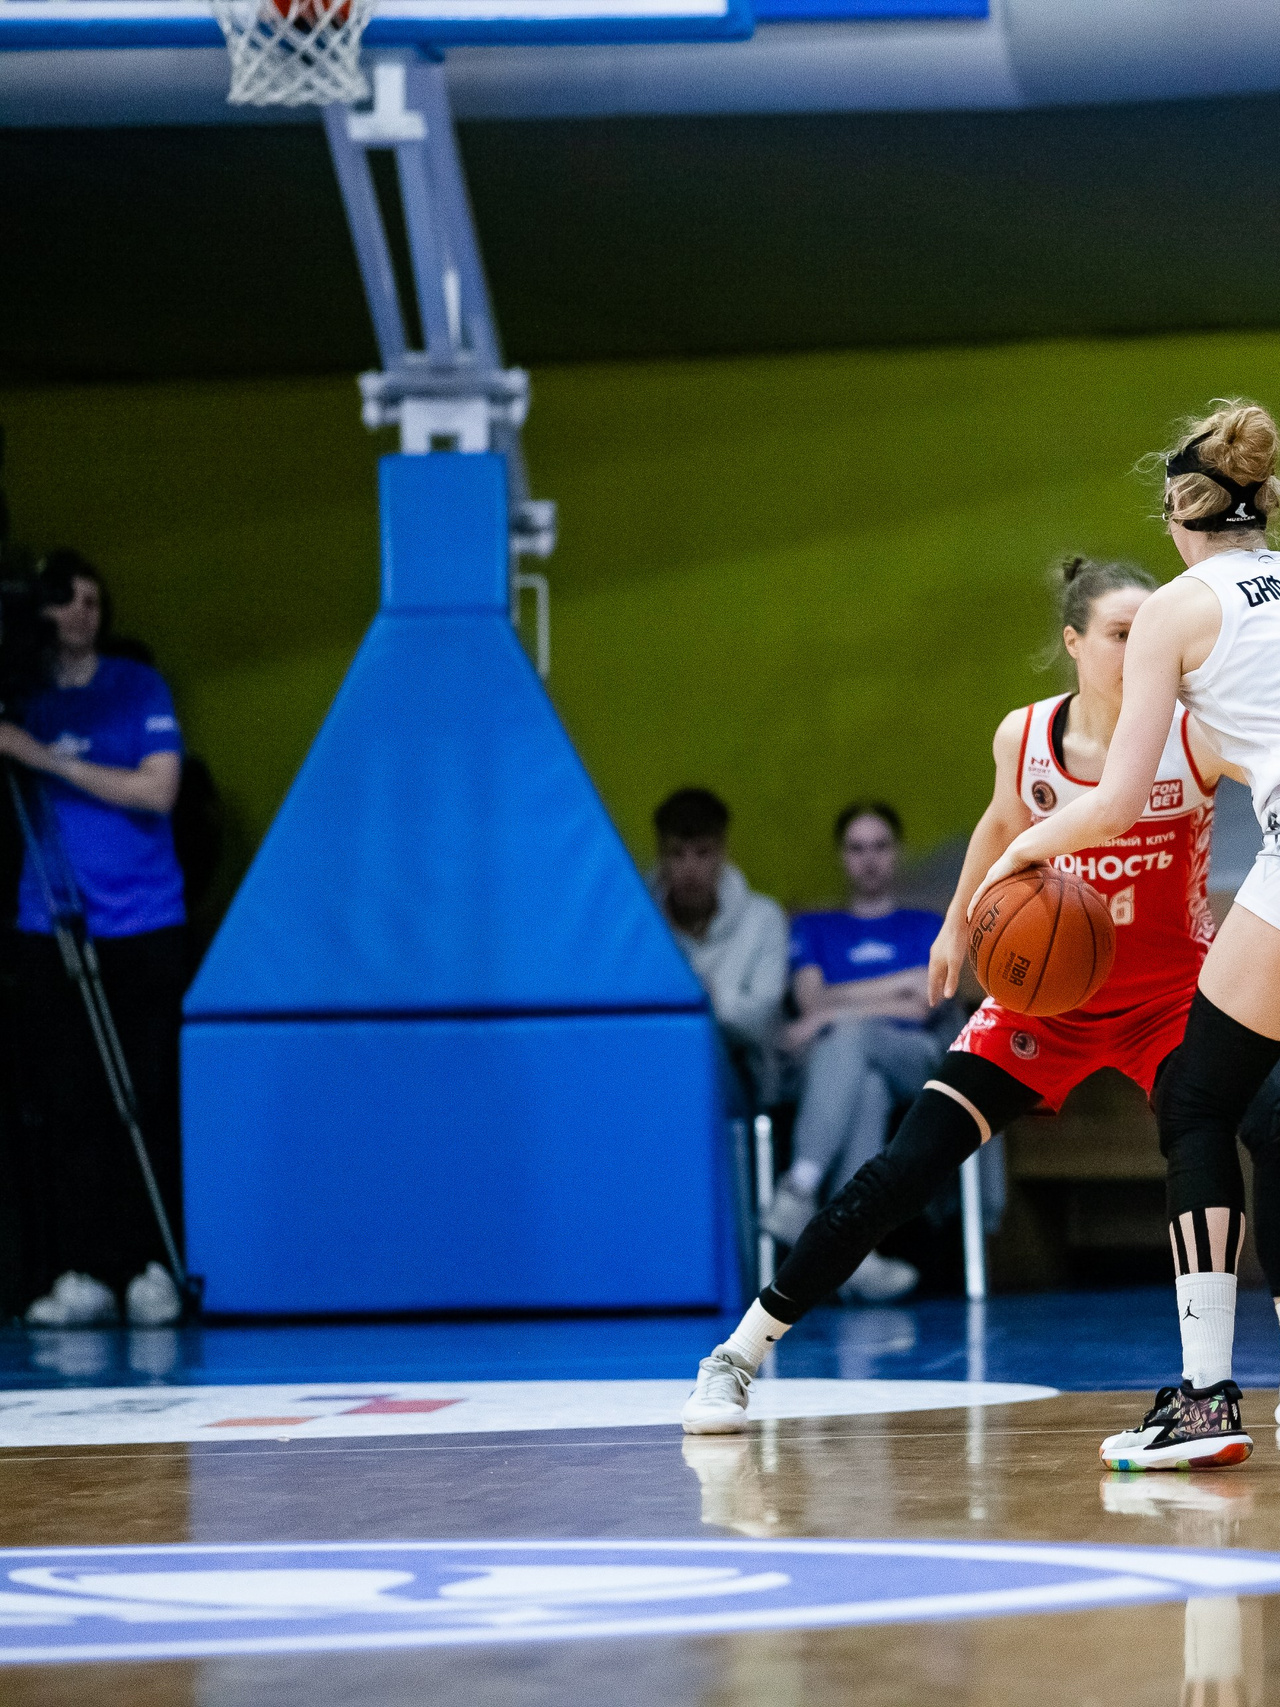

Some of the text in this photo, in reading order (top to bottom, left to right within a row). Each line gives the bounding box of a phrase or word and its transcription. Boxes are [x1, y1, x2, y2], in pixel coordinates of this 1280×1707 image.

[1152, 781, 1180, 796] FON
[1152, 793, 1181, 808] BET
[1098, 830, 1176, 847] ЬНЫЙ КЛУБ
[1054, 851, 1174, 881] ЮНОСТЬ
[1009, 955, 1031, 987] FIBA
